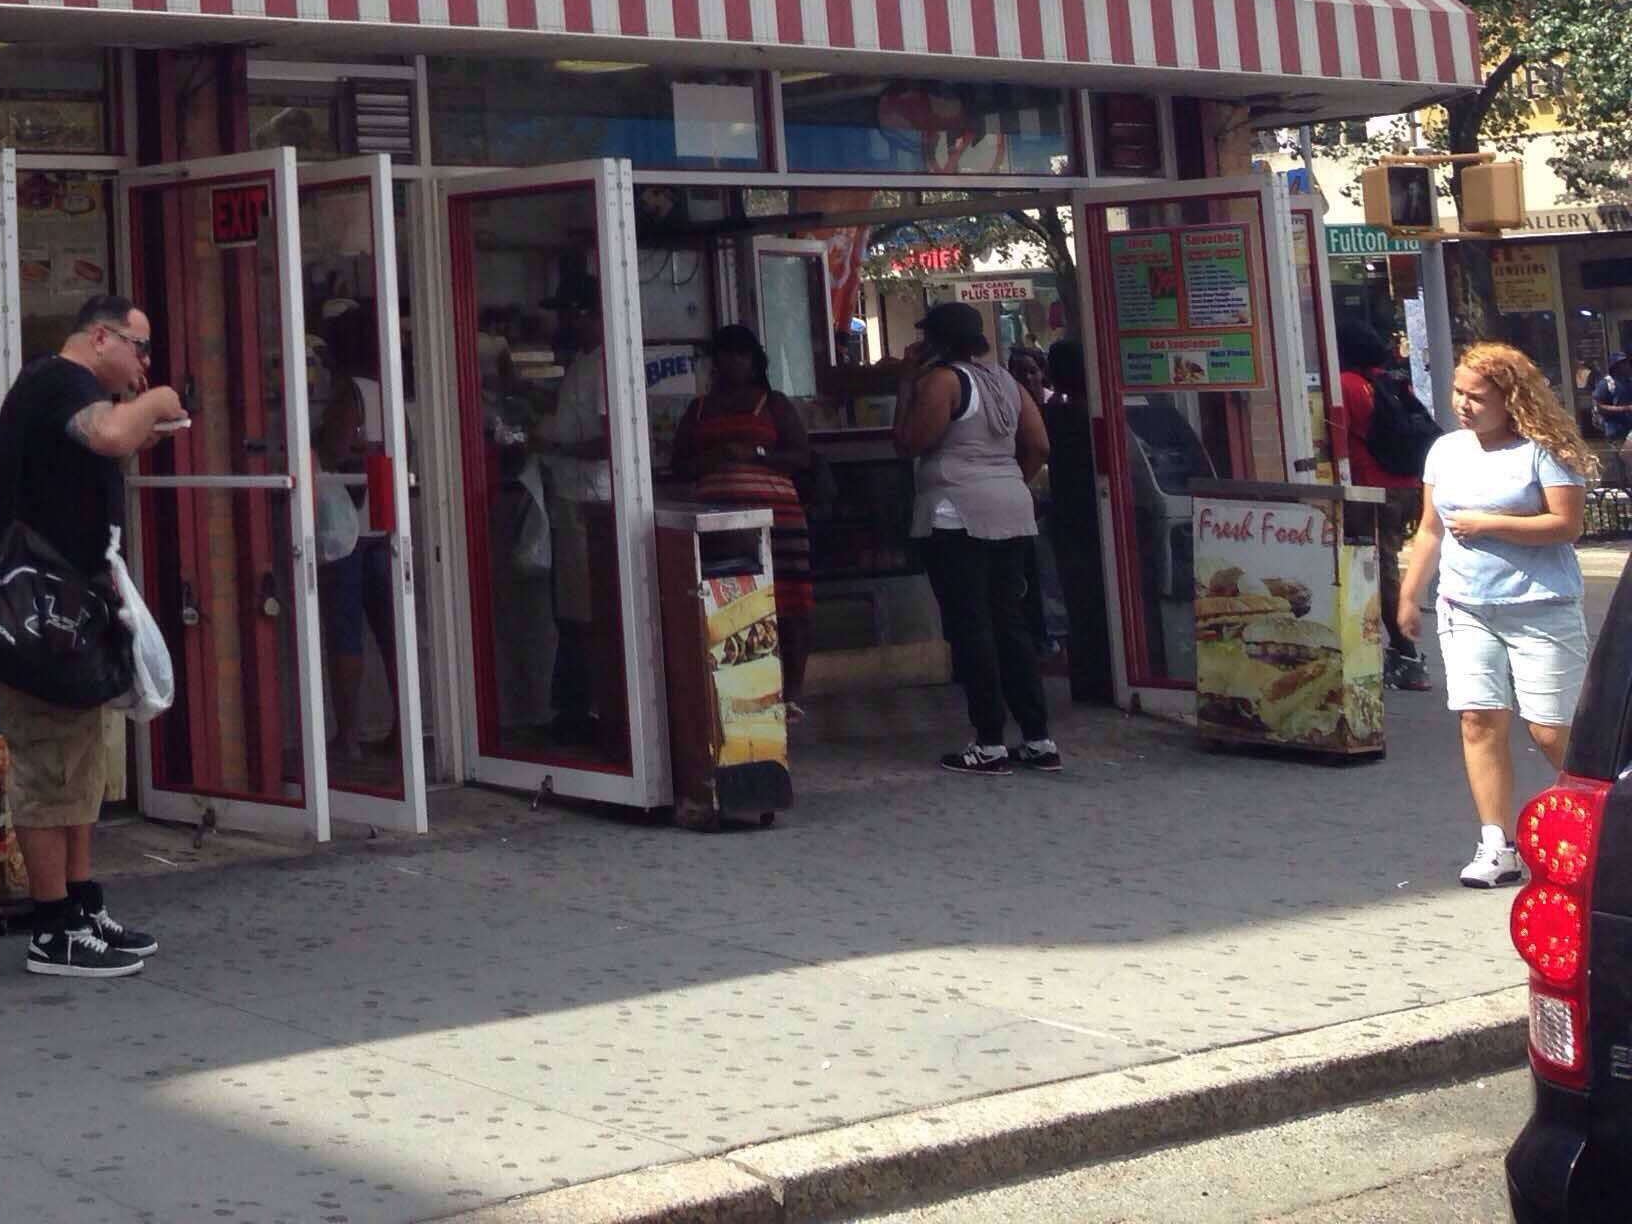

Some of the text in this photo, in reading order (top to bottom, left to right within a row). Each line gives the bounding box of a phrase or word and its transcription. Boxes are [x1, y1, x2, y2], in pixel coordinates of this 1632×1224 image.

[215, 187, 267, 240] EXIT
[1522, 213, 1591, 230] ALLERY
[1329, 227, 1388, 252] Fulton
[961, 287, 1027, 301] PLUS SIZES
[1199, 507, 1254, 542] Fresh
[1261, 512, 1313, 546] Food
